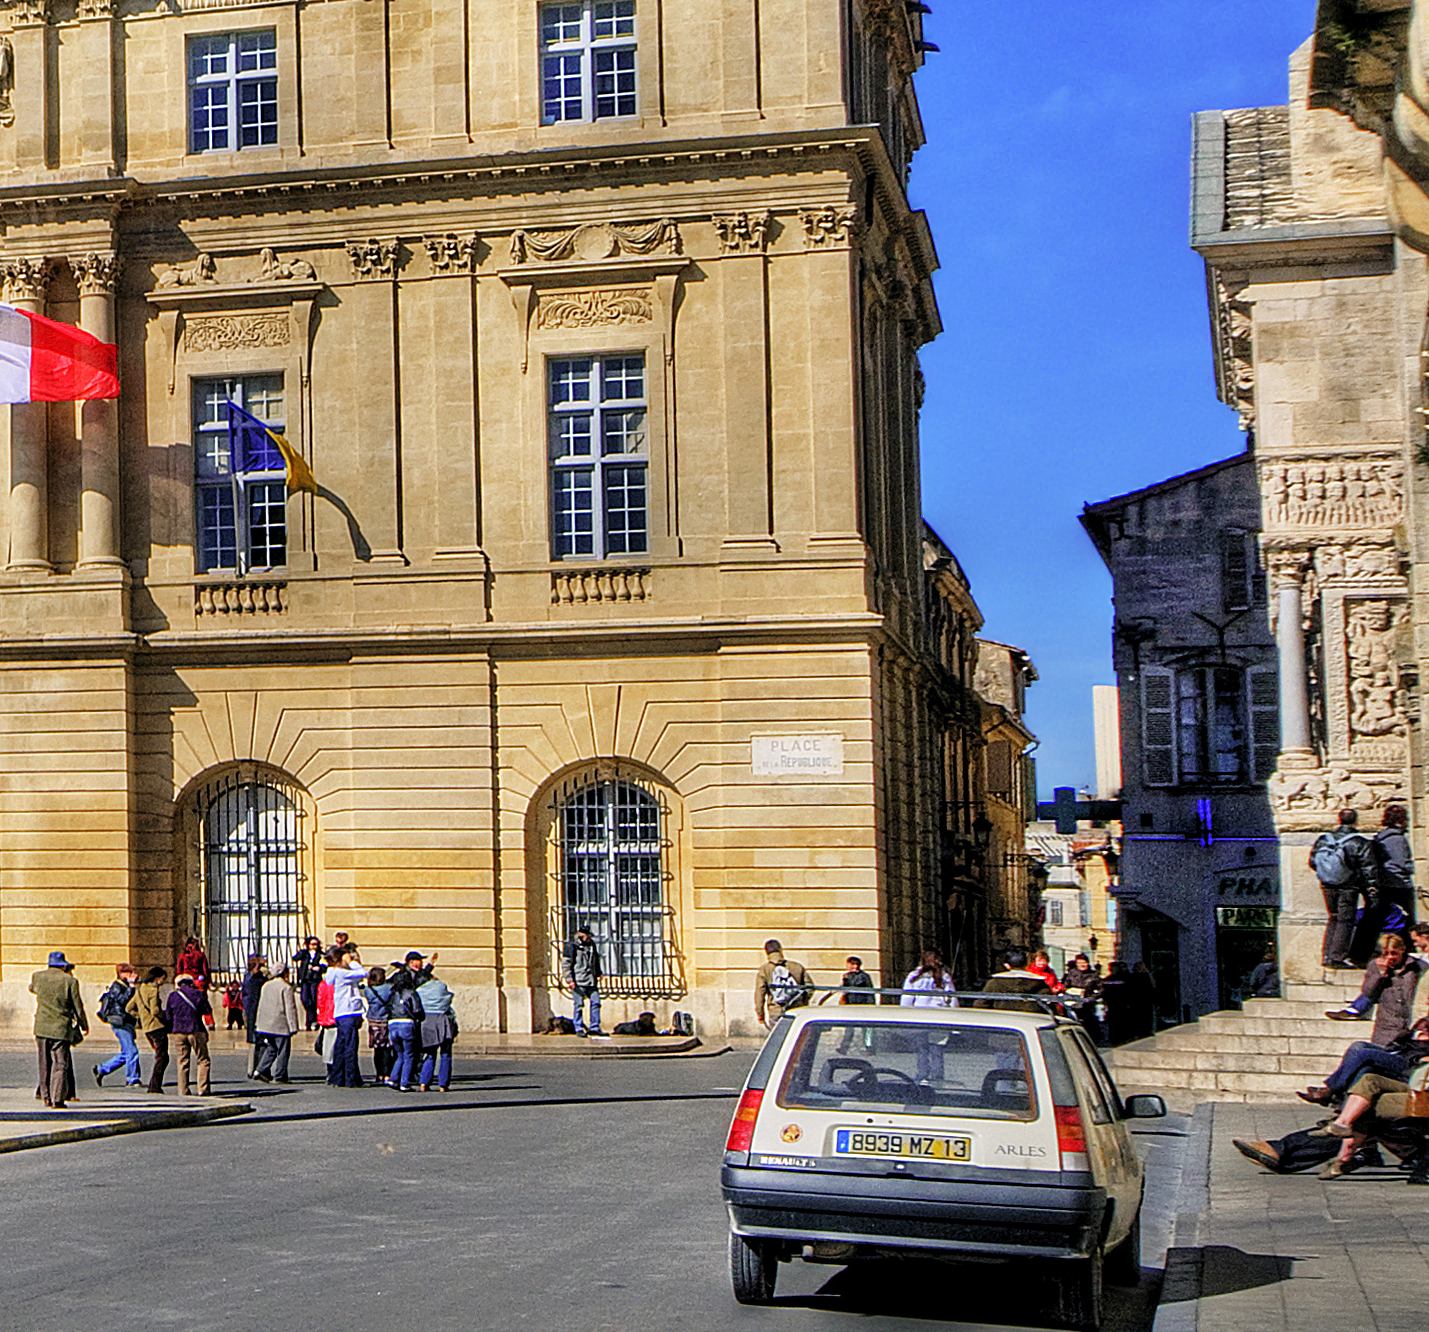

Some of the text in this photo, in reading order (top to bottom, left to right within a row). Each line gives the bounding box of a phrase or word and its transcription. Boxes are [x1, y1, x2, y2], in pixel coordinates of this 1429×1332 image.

[771, 739, 821, 752] PLACE
[852, 1133, 966, 1158] 8939 MZ 13
[994, 1144, 1047, 1158] ARLES
[760, 1156, 808, 1167] RENAULT
